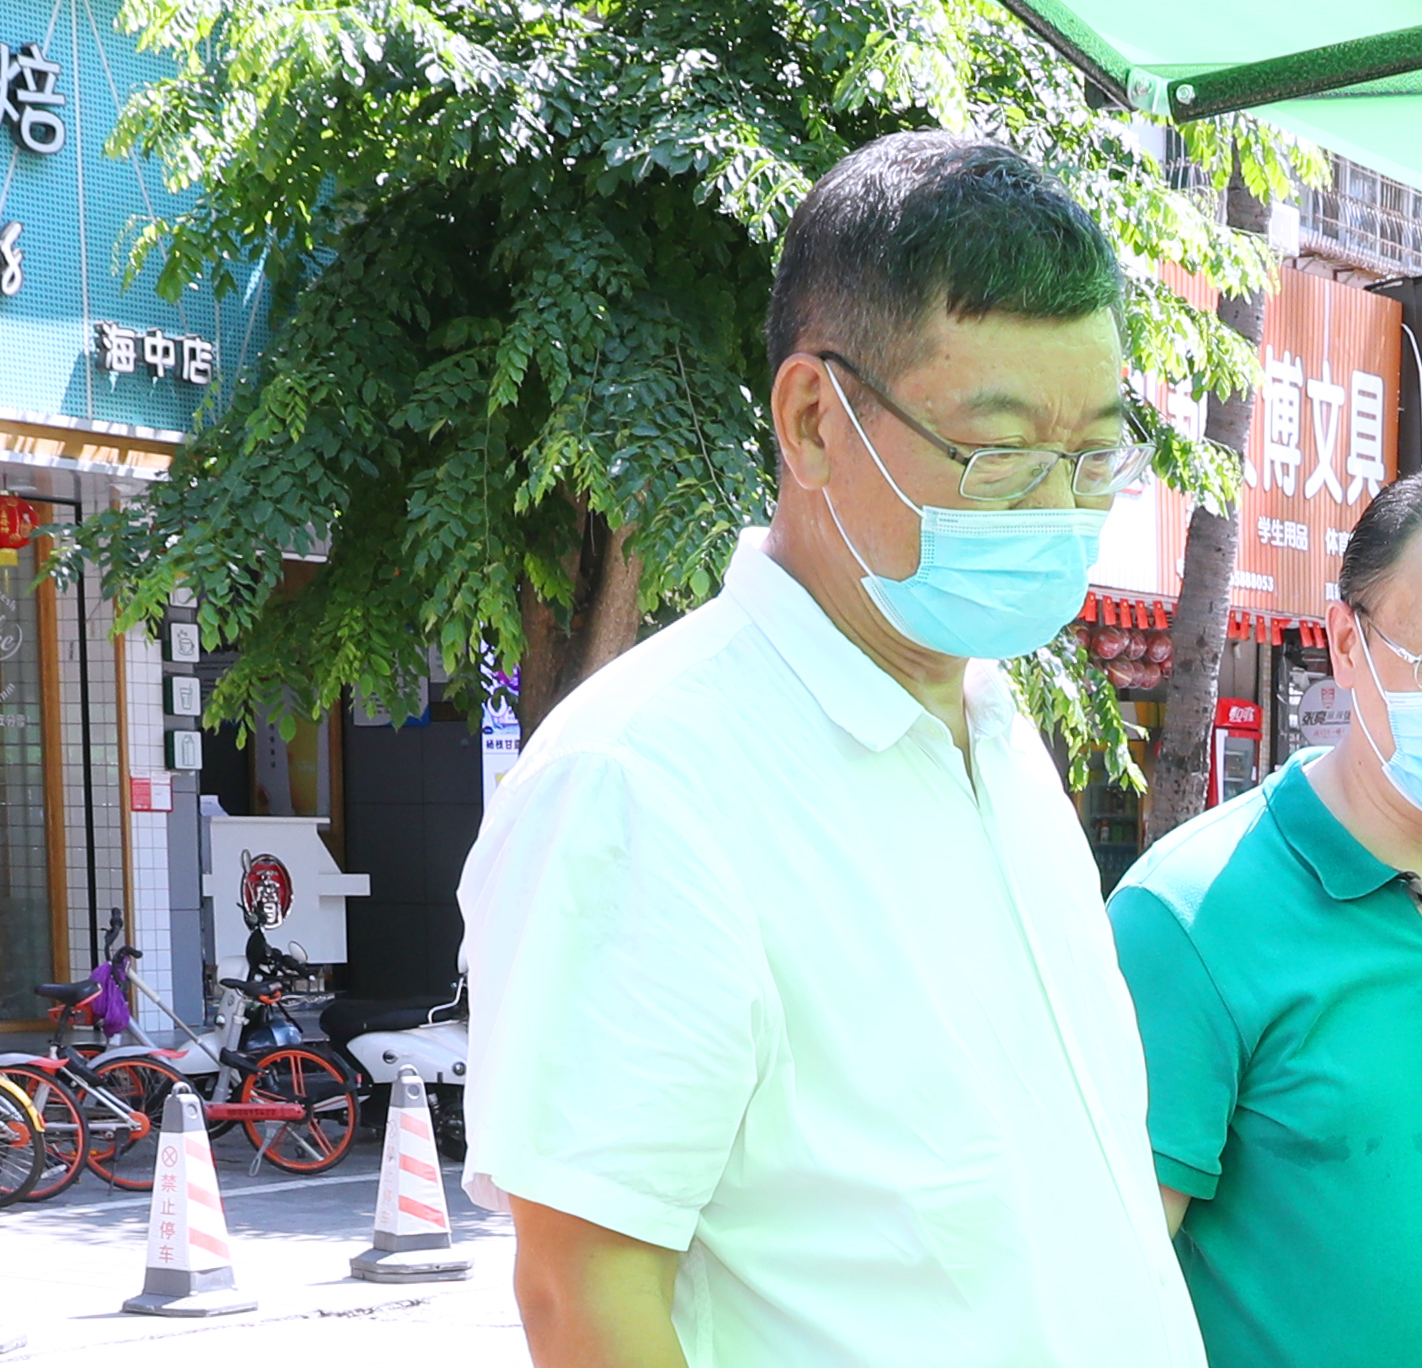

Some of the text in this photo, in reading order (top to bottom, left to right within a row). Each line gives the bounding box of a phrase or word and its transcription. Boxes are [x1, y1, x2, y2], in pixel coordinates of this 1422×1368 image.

[101, 321, 212, 385] 海中店
[1243, 344, 1385, 505] 博文具
[1257, 516, 1355, 557] 学生用品 体育
[160, 1174, 176, 1264] 禁止停车
